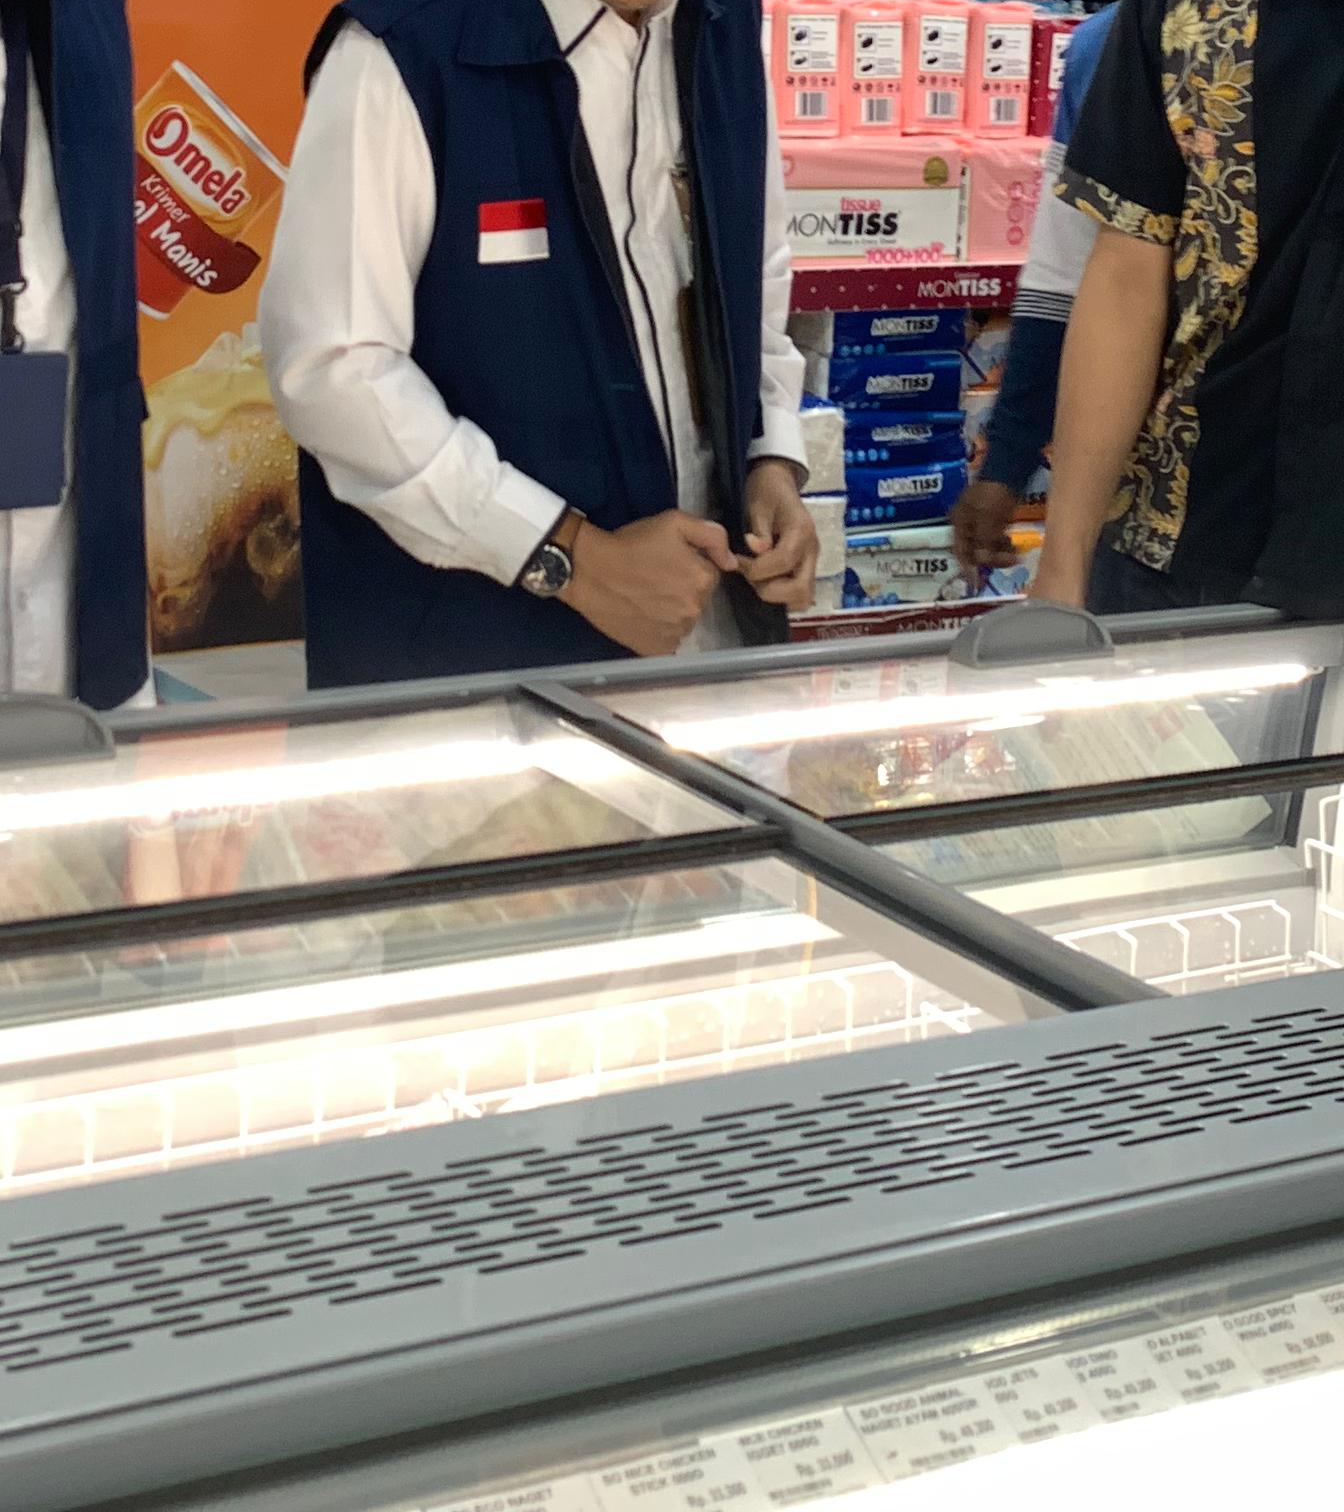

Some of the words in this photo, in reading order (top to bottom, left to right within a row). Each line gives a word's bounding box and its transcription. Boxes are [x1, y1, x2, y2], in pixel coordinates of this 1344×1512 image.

[143, 106, 250, 216] Omela
[140, 174, 191, 223] Krimer
[840, 196, 882, 212] tissue
[151, 217, 219, 288] Manis
[917, 278, 1002, 298] MONTISS
[871, 317, 937, 333] MONTISS
[879, 477, 941, 494] MONTISS
[876, 559, 949, 575] MONTISS
[896, 616, 970, 633] MONTIS
